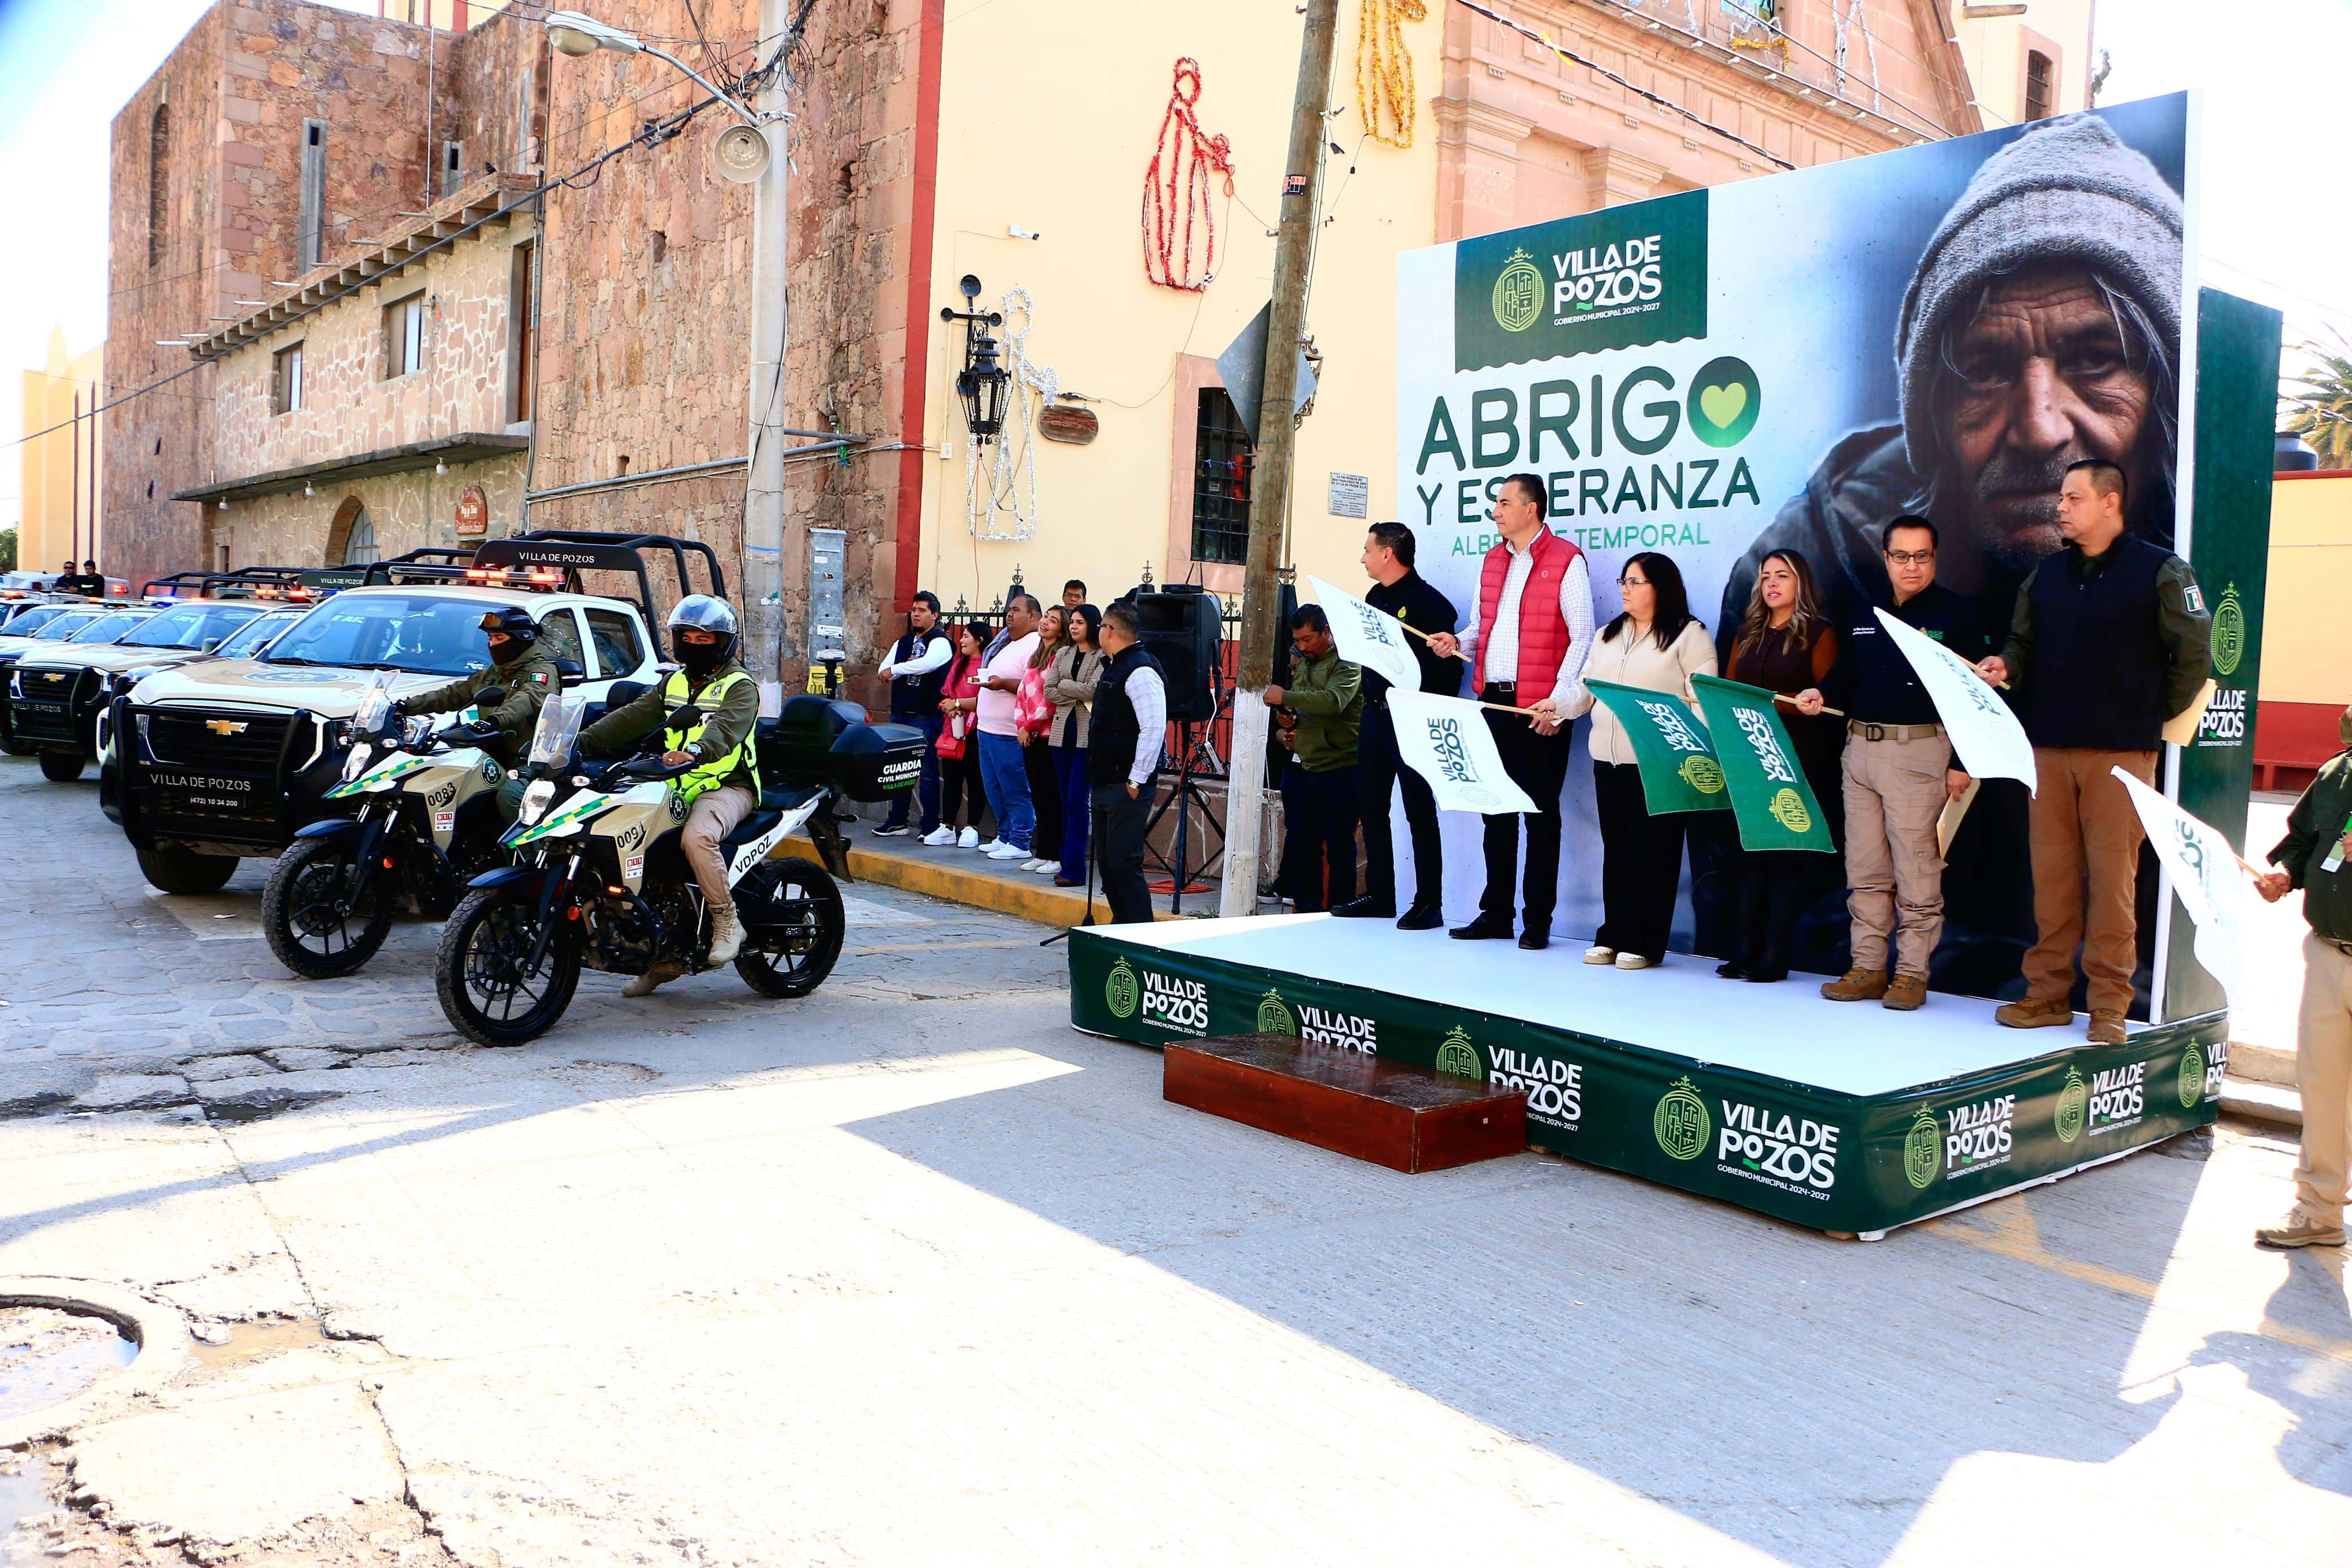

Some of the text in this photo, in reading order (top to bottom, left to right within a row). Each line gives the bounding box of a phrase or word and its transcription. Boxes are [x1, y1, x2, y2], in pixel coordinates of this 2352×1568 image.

[1553, 235, 1661, 279] VILLA DE
[1554, 264, 1662, 314] POZOS
[1554, 302, 1660, 326] GOBIERNO MUNICIPAL 2024-2027
[1416, 356, 1761, 475] ABRIGO
[1417, 483, 1442, 525] Y
[1458, 457, 1760, 523] ESERANZA
[1574, 522, 1710, 549] TEMPORAL
[519, 552, 595, 563] VILLA DE POZOS
[2231, 690, 2246, 709] DE
[1654, 703, 1705, 751] POZOS
[2198, 711, 2245, 737] POZOS
[1428, 718, 1458, 781] VILLA DE
[1442, 718, 1477, 782] POZOS
[1732, 707, 1779, 781] VILLA DE
[1745, 709, 1794, 782] POZOS
[150, 774, 250, 791] VILLA DE POZOS
[883, 759, 922, 774] GUARDIA
[427, 782, 455, 806] 0083
[617, 821, 646, 848] 0091
[628, 857, 641, 866] 911
[736, 835, 772, 873] VDPOZ
[1143, 971, 1207, 1002] VILLA DE
[1142, 1018, 1206, 1037] GOBIERNO MUNICIPAL 2024-2027
[1143, 991, 1208, 1028] POZOS
[1297, 1004, 1376, 1041] VILLA DE
[1488, 1045, 1582, 1089] VILLA DE
[2092, 1062, 2146, 1094] VILLA DE
[1947, 1094, 2015, 1133] VILLA DE
[2089, 1085, 2143, 1126] POZOS
[1547, 1117, 1578, 1132] 2024-2027
[1722, 1099, 1840, 1153] VILLA DE
[1718, 1128, 1835, 1188] POZOS
[1946, 1120, 2012, 1168] POZOS
[1717, 1164, 1830, 1201] GOBIERNO MUNICIPAL 2024-2027
